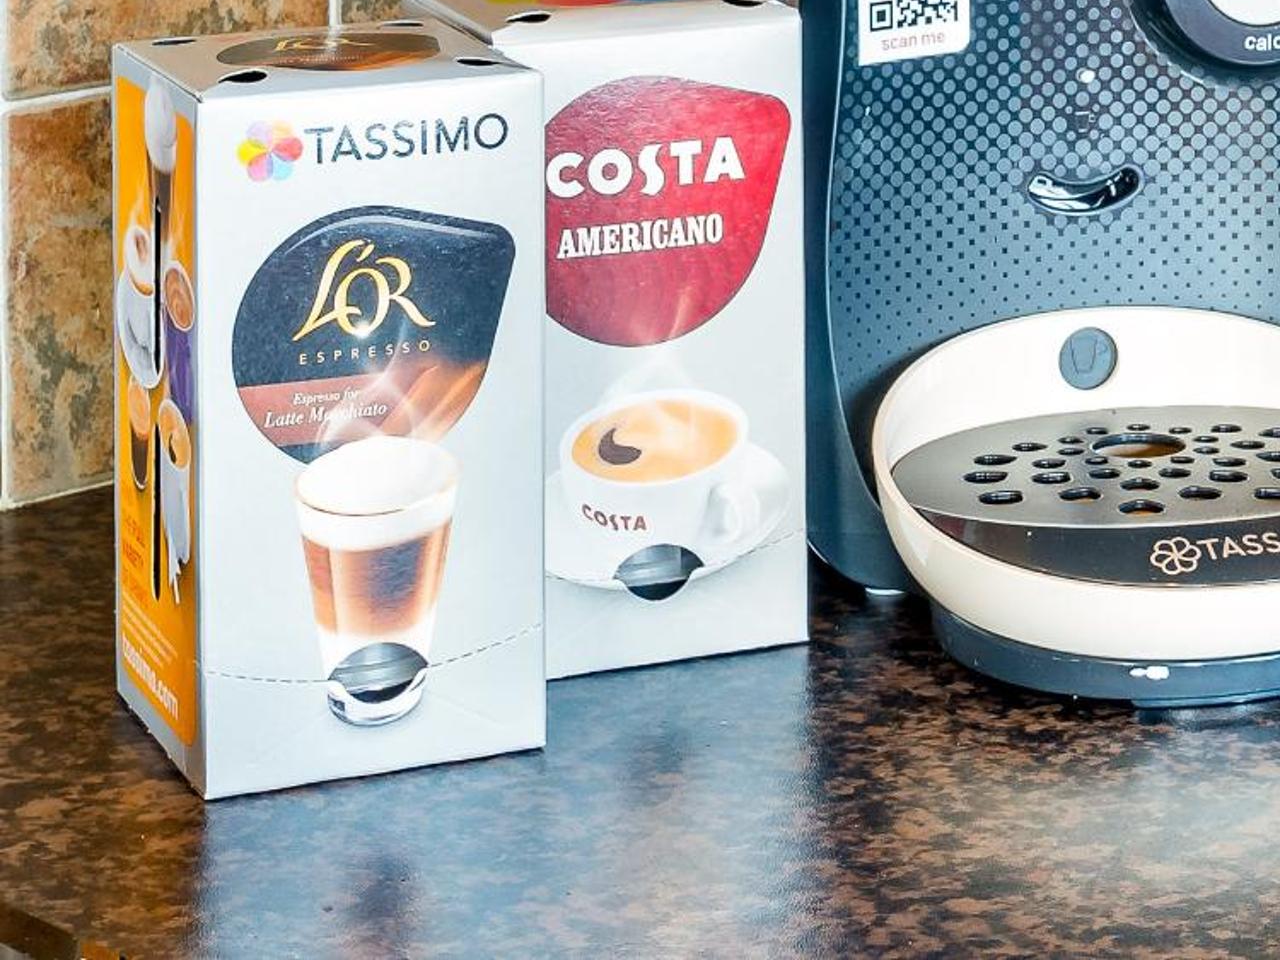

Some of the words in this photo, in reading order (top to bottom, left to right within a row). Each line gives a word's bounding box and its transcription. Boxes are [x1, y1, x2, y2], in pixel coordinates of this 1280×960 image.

[881, 35, 917, 51] scan
[922, 31, 945, 46] me
[304, 113, 509, 164] TASSIMO
[545, 136, 745, 198] COSTA
[556, 213, 723, 259] AMERICANO
[299, 340, 431, 365] ESPRESSO
[264, 411, 303, 428] Latte
[582, 504, 647, 531] COSTA
